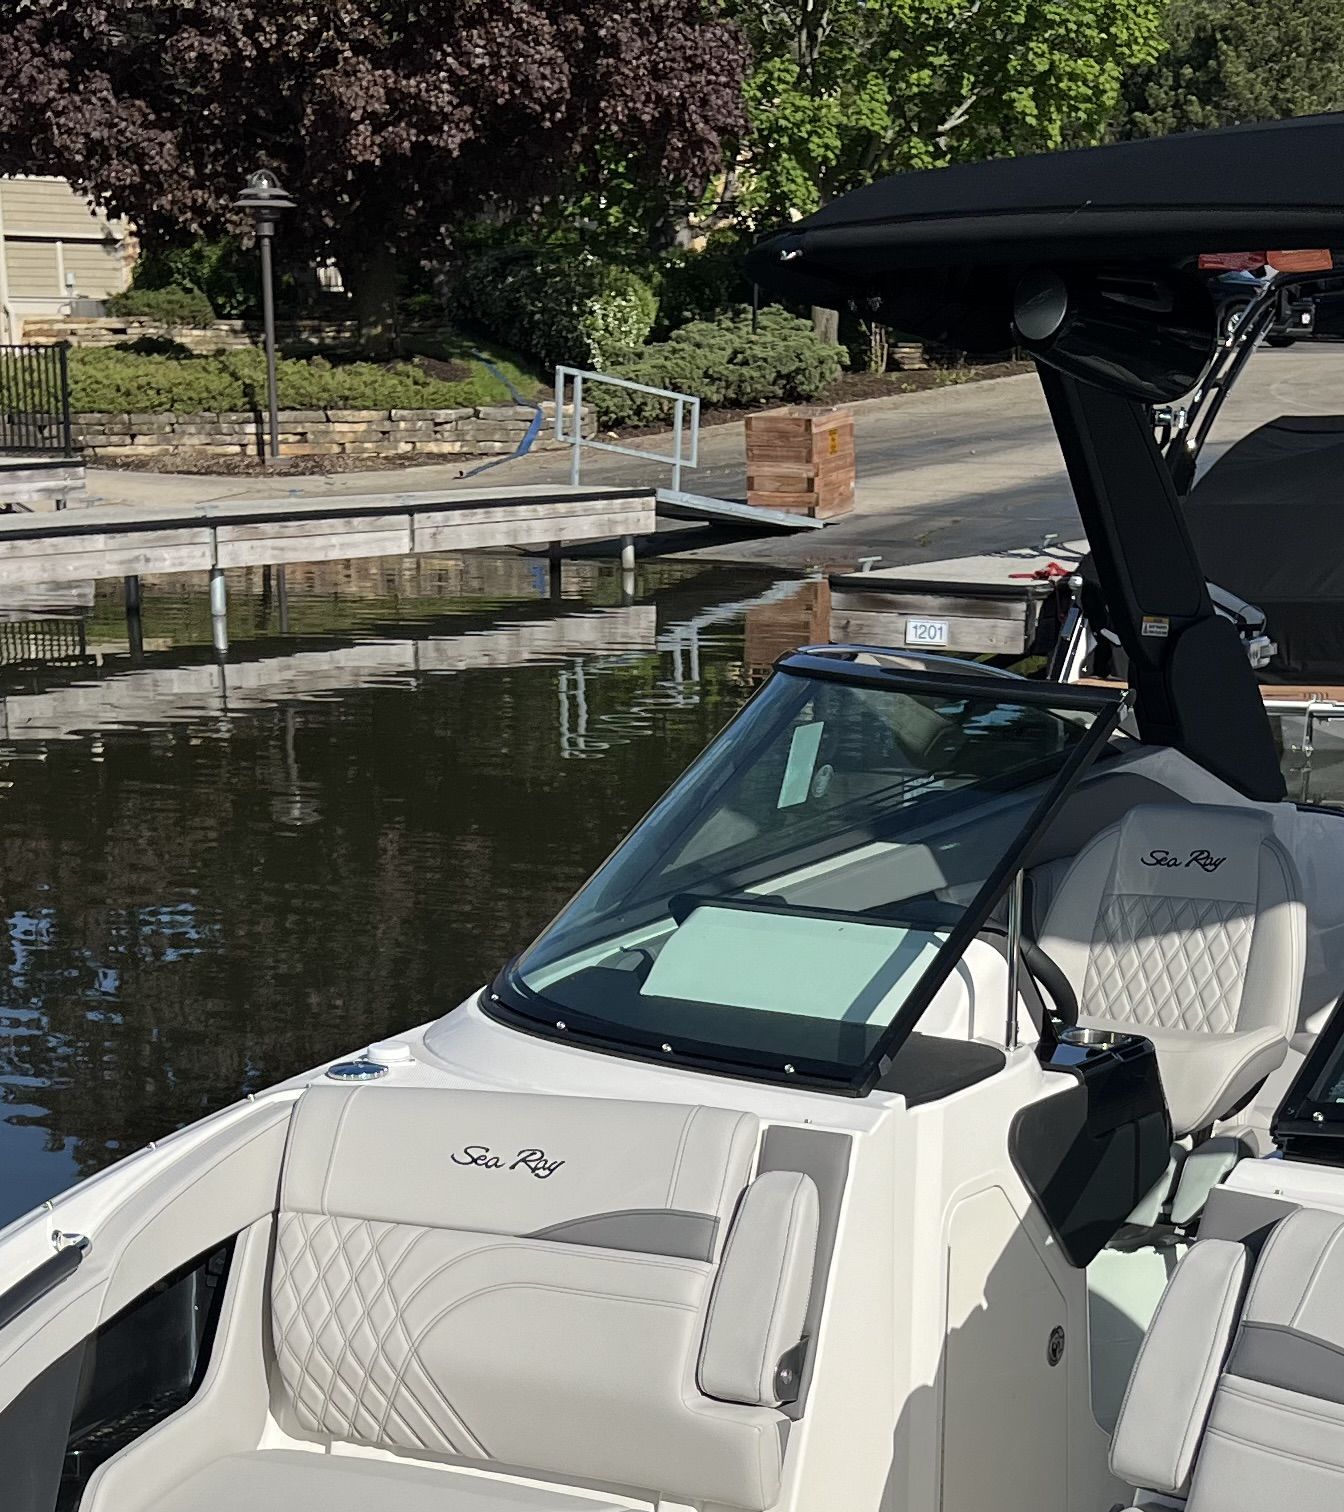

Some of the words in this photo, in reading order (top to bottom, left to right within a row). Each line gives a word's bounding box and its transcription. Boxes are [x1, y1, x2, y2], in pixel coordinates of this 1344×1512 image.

[911, 624, 943, 641] 1201
[1140, 849, 1182, 868] Sea
[1184, 849, 1227, 873] Ray
[450, 1145, 505, 1169] Sea
[509, 1148, 566, 1179] Ray
